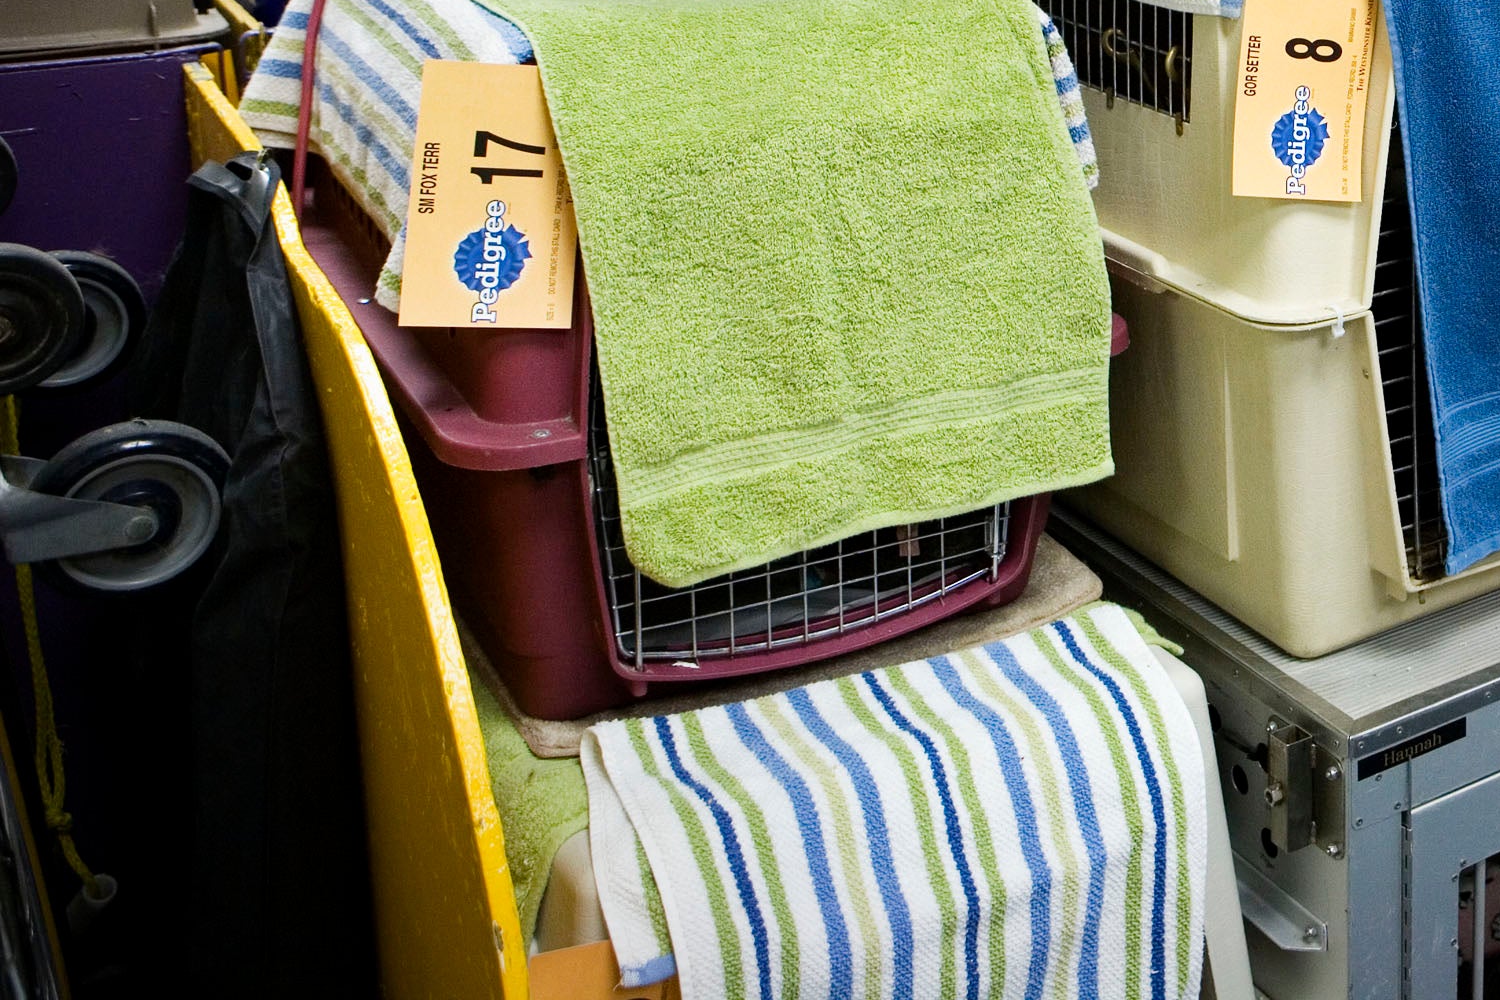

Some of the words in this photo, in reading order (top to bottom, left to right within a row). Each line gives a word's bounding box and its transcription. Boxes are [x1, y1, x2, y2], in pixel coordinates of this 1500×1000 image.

[1245, 35, 1261, 73] SETTER
[1284, 37, 1343, 63] 8
[1244, 75, 1259, 96] GOR
[1285, 85, 1311, 195] Pedigree
[422, 142, 441, 171] TERR
[470, 130, 546, 185] 17
[420, 174, 438, 195] FOX
[418, 198, 435, 214] SM
[471, 199, 507, 323] Pedigree
[1384, 733, 1442, 768] Hannah
